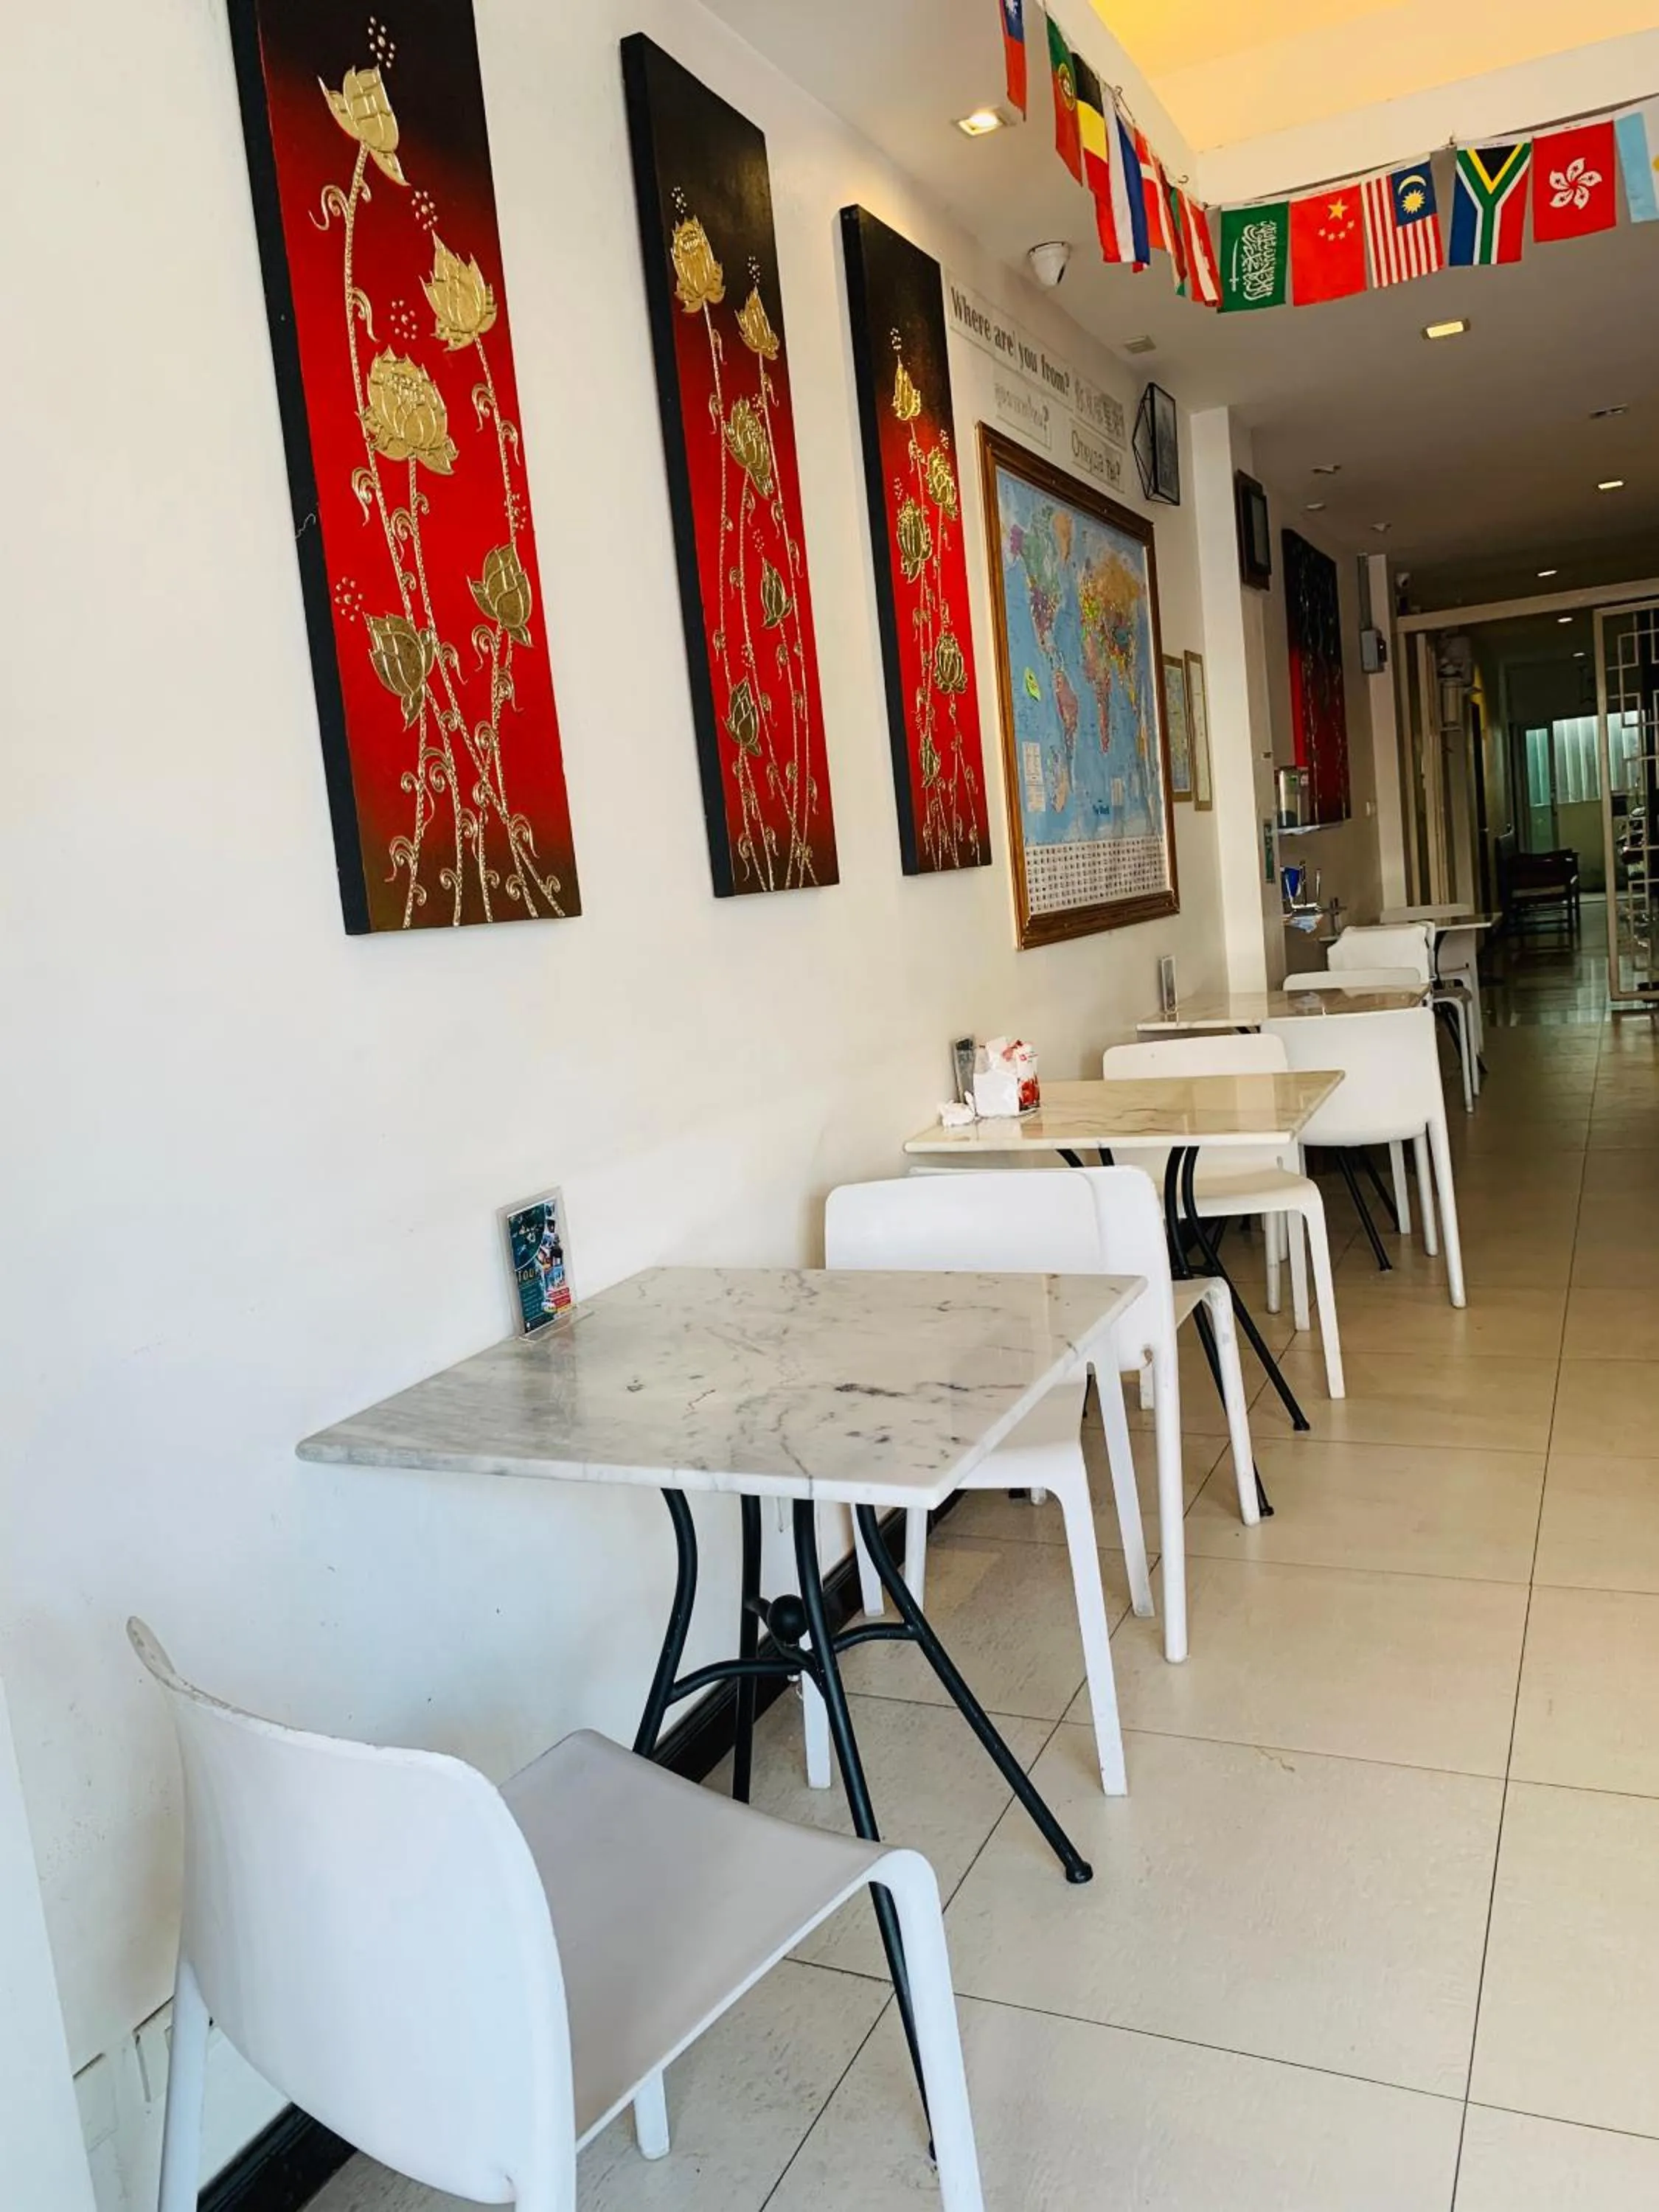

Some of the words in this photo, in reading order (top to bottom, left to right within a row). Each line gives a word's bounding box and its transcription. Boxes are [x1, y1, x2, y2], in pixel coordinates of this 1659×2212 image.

[951, 286, 992, 341] Where
[995, 325, 1015, 357] are
[1018, 341, 1038, 373] you
[1041, 353, 1070, 398] from?
